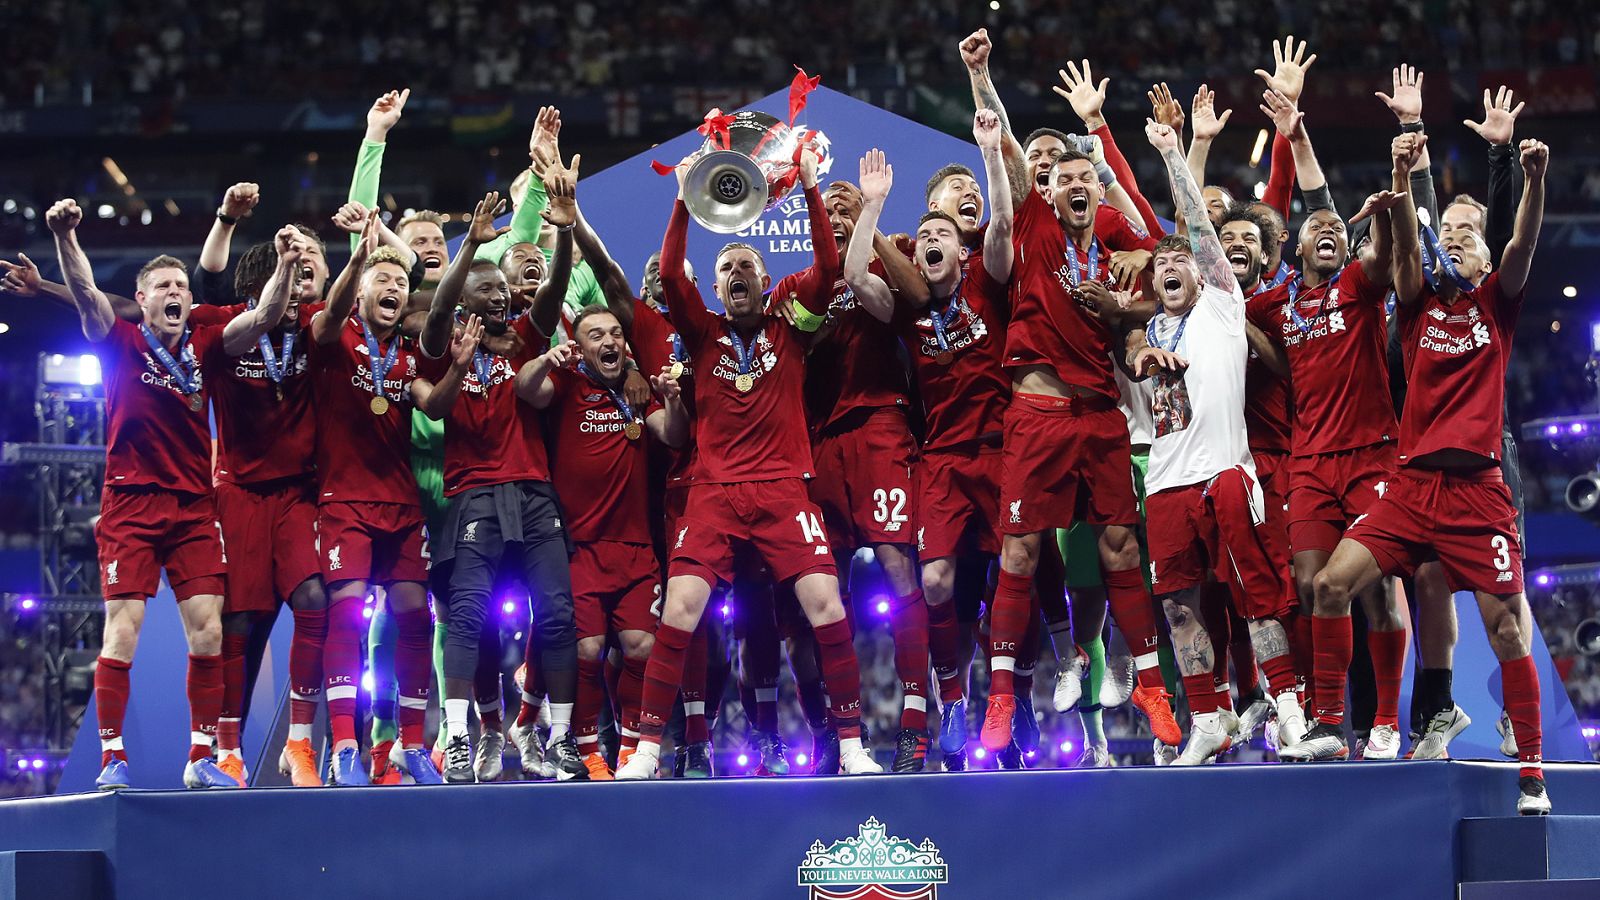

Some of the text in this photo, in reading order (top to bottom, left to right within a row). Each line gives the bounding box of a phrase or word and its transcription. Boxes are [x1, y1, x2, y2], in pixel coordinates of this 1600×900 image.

[1420, 336, 1473, 354] Chartered
[357, 364, 402, 389] Staard
[873, 488, 908, 522] 32
[796, 511, 827, 543] 14
[1491, 535, 1511, 570] 3
[802, 868, 944, 881] YOU'LL NEVER WALK ALONE
